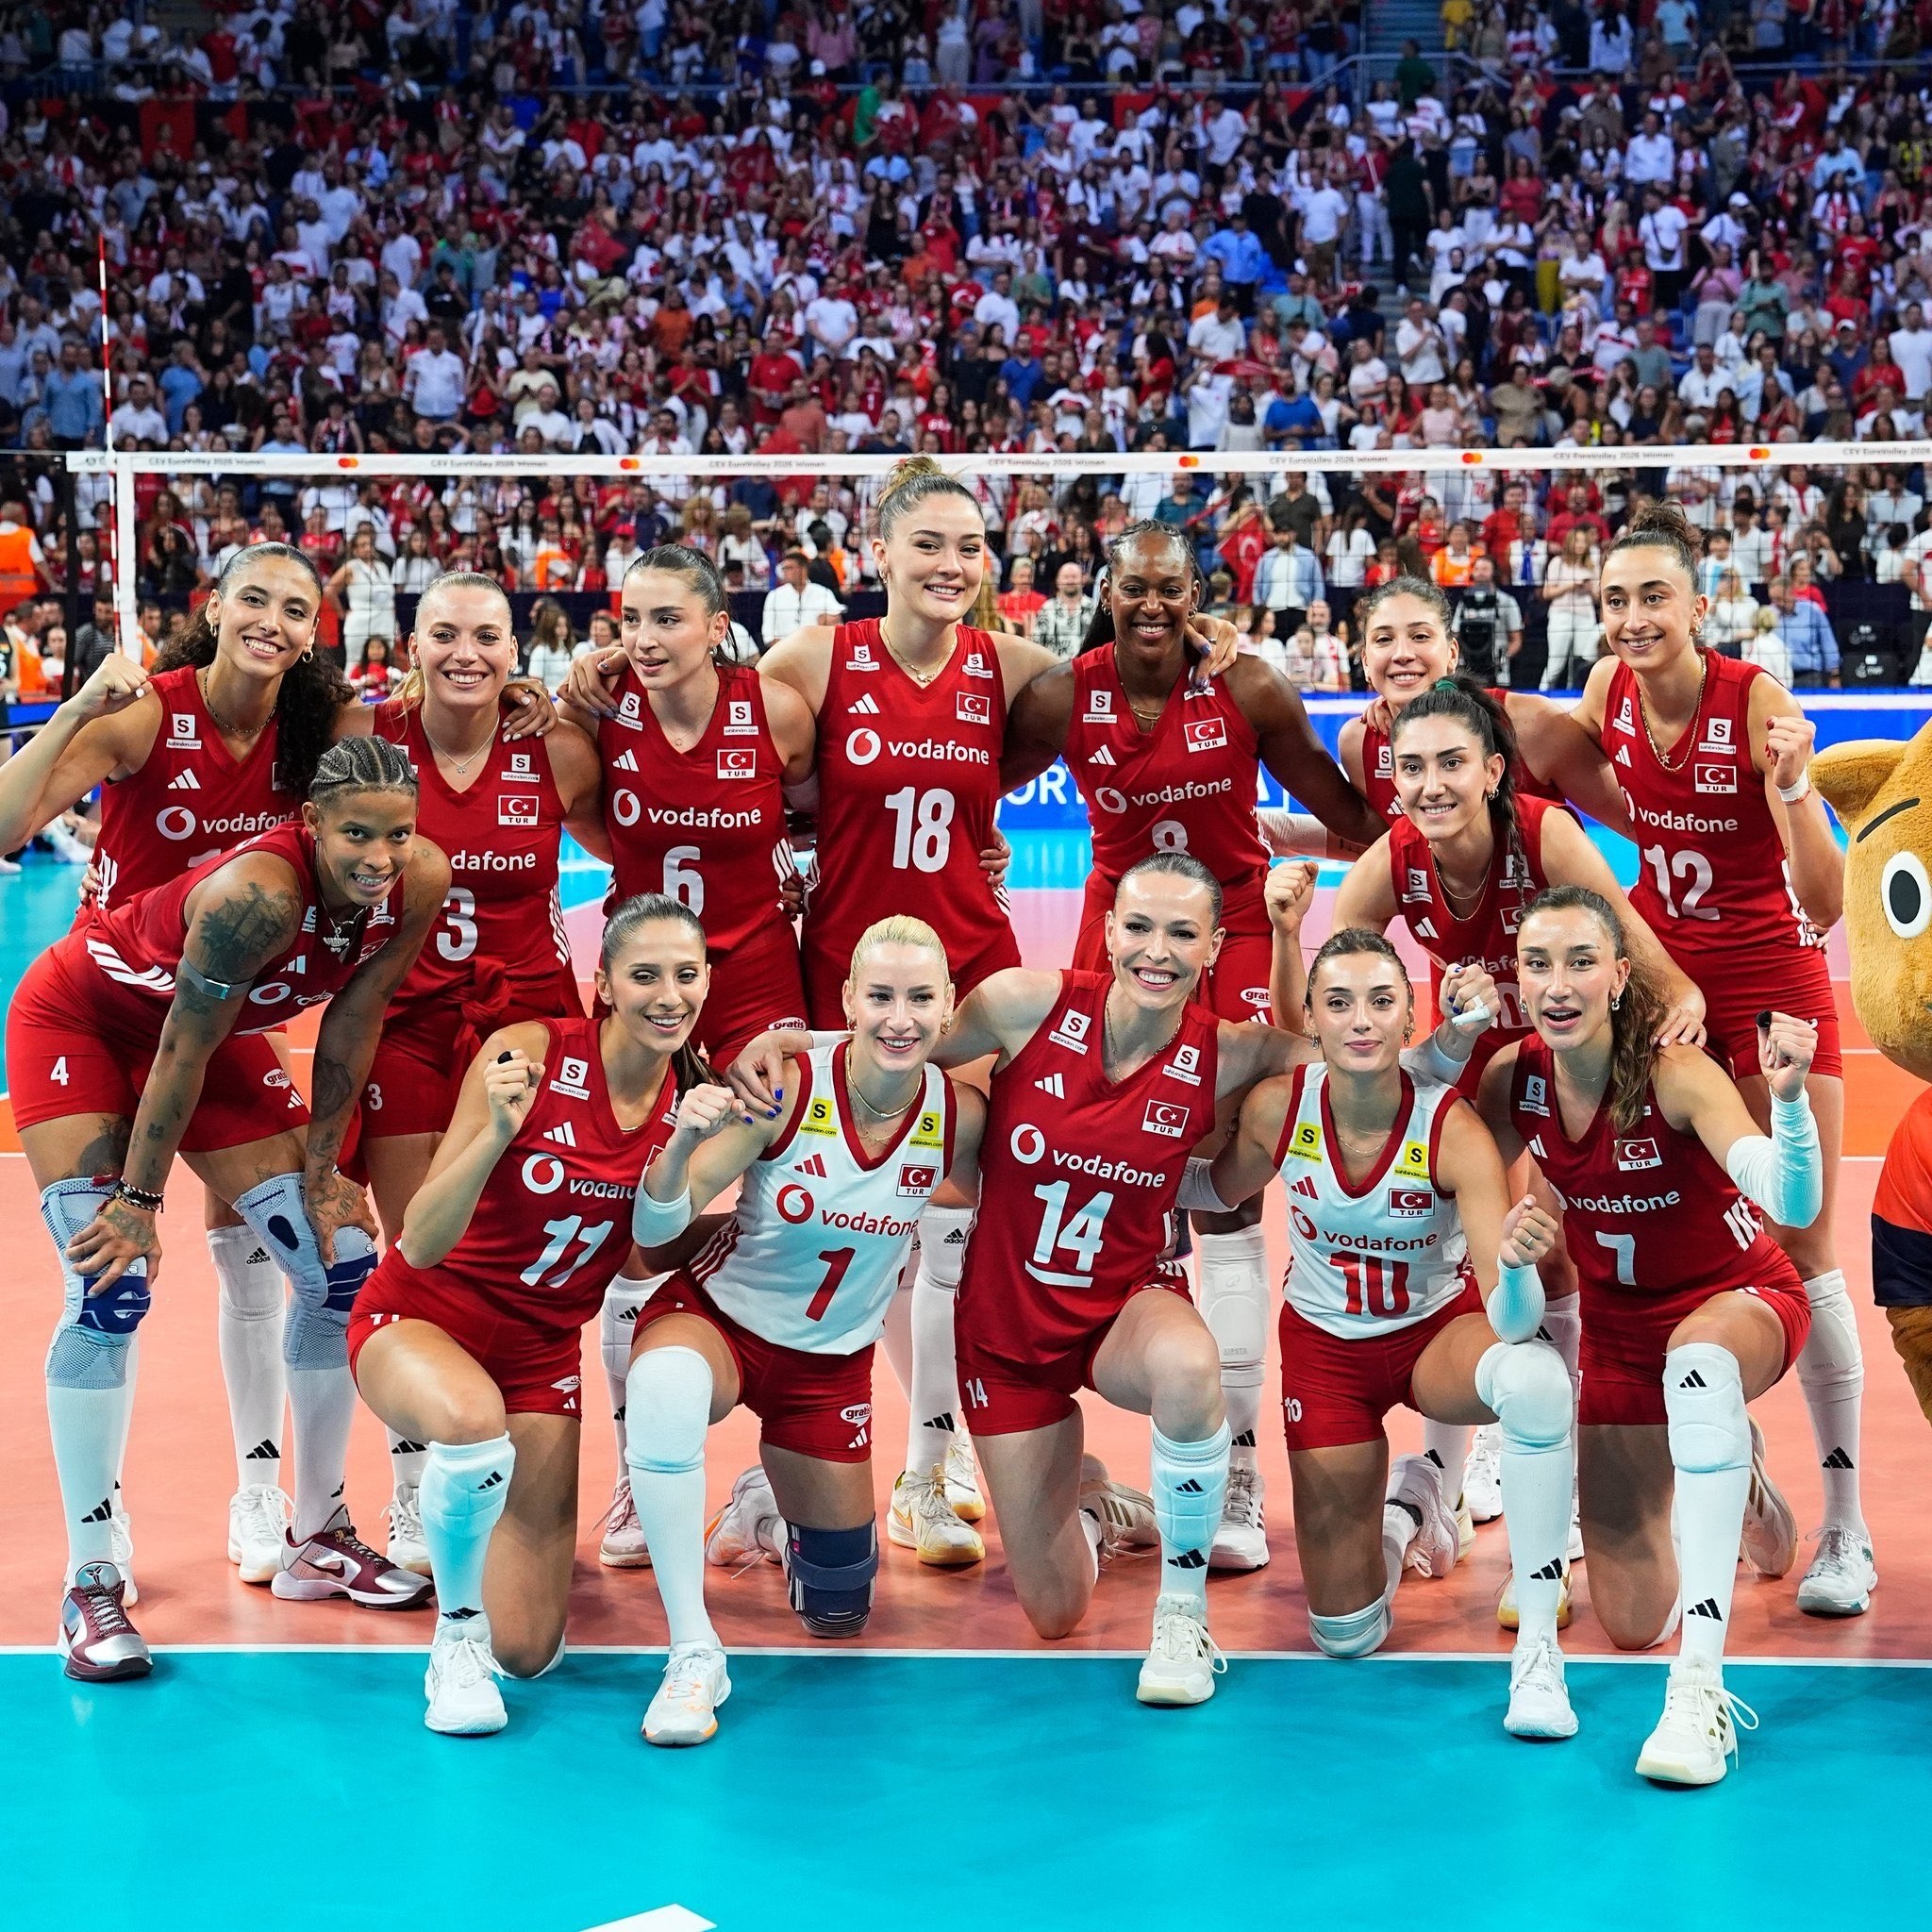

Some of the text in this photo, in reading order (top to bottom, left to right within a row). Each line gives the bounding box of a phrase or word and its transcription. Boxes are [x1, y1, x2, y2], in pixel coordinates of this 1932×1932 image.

[858, 649, 867, 658] S
[972, 657, 979, 665] S
[626, 697, 638, 712] S
[1095, 695, 1106, 708] S
[735, 707, 746, 720] S
[964, 713, 982, 722] TUR
[1624, 704, 1631, 717] S
[176, 719, 190, 733] S
[1713, 724, 1725, 738] S
[888, 739, 990, 765] vodafone
[1197, 740, 1218, 749] TUR
[516, 758, 526, 768] S
[1381, 751, 1390, 764] S
[1132, 776, 1233, 807] vodafone
[647, 808, 761, 828] vodafone
[1638, 807, 1738, 832] vodafone
[884, 786, 956, 874] 18
[451, 850, 536, 871] dafone
[663, 846, 704, 916] 6
[1411, 874, 1422, 886] S
[1643, 844, 1721, 921] 12
[436, 887, 478, 961] 3
[1245, 991, 1269, 1000] grat
[774, 1020, 804, 1030] gratis
[1068, 1017, 1083, 1032] S
[1181, 1051, 1193, 1066] S
[50, 1057, 69, 1086] 4
[566, 1064, 581, 1079] S
[1532, 1081, 1541, 1096] S
[368, 1083, 383, 1110] 3
[813, 1104, 826, 1119] S
[923, 1117, 934, 1132] S
[1153, 1125, 1174, 1135] TUR
[1301, 1129, 1315, 1144] S
[1410, 1148, 1423, 1164] S
[1053, 1150, 1166, 1188] vodafone
[1628, 1160, 1652, 1169] TUR
[1568, 1190, 1681, 1214] vodafone
[822, 1209, 919, 1237] vodafone
[1034, 1180, 1114, 1273] 14
[1324, 1231, 1438, 1251] vodafone
[520, 1214, 614, 1289] 11
[1595, 1230, 1637, 1286] 7
[246, 1256, 271, 1265] adidas
[806, 1247, 856, 1322] 1
[1330, 1250, 1410, 1317] 10
[966, 1378, 988, 1408] 14
[1285, 1397, 1302, 1423] 10
